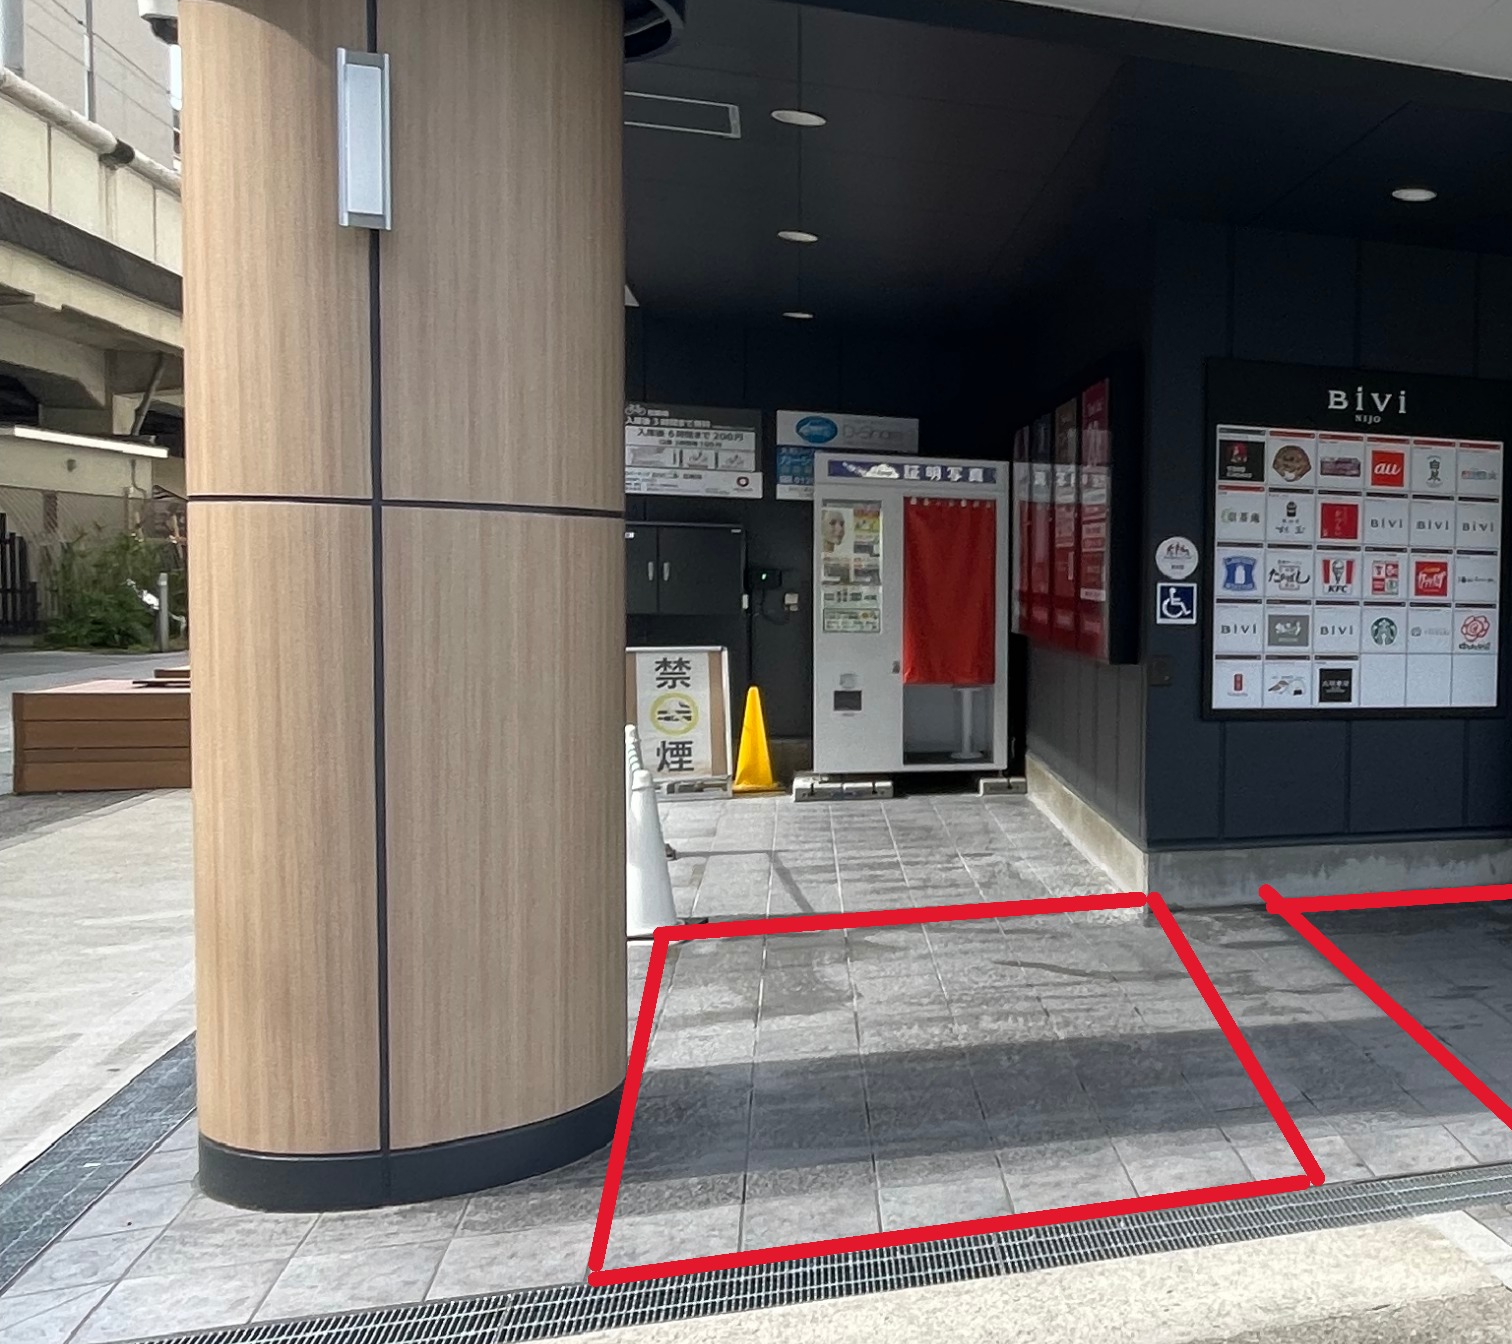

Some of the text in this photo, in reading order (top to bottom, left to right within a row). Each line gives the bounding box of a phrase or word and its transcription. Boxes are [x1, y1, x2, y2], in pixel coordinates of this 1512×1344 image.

[1328, 386, 1406, 414] BiVi
[1355, 415, 1381, 424] NIJO
[904, 464, 984, 483] 証明写真
[1374, 462, 1402, 475] au
[1328, 585, 1348, 594] KFC
